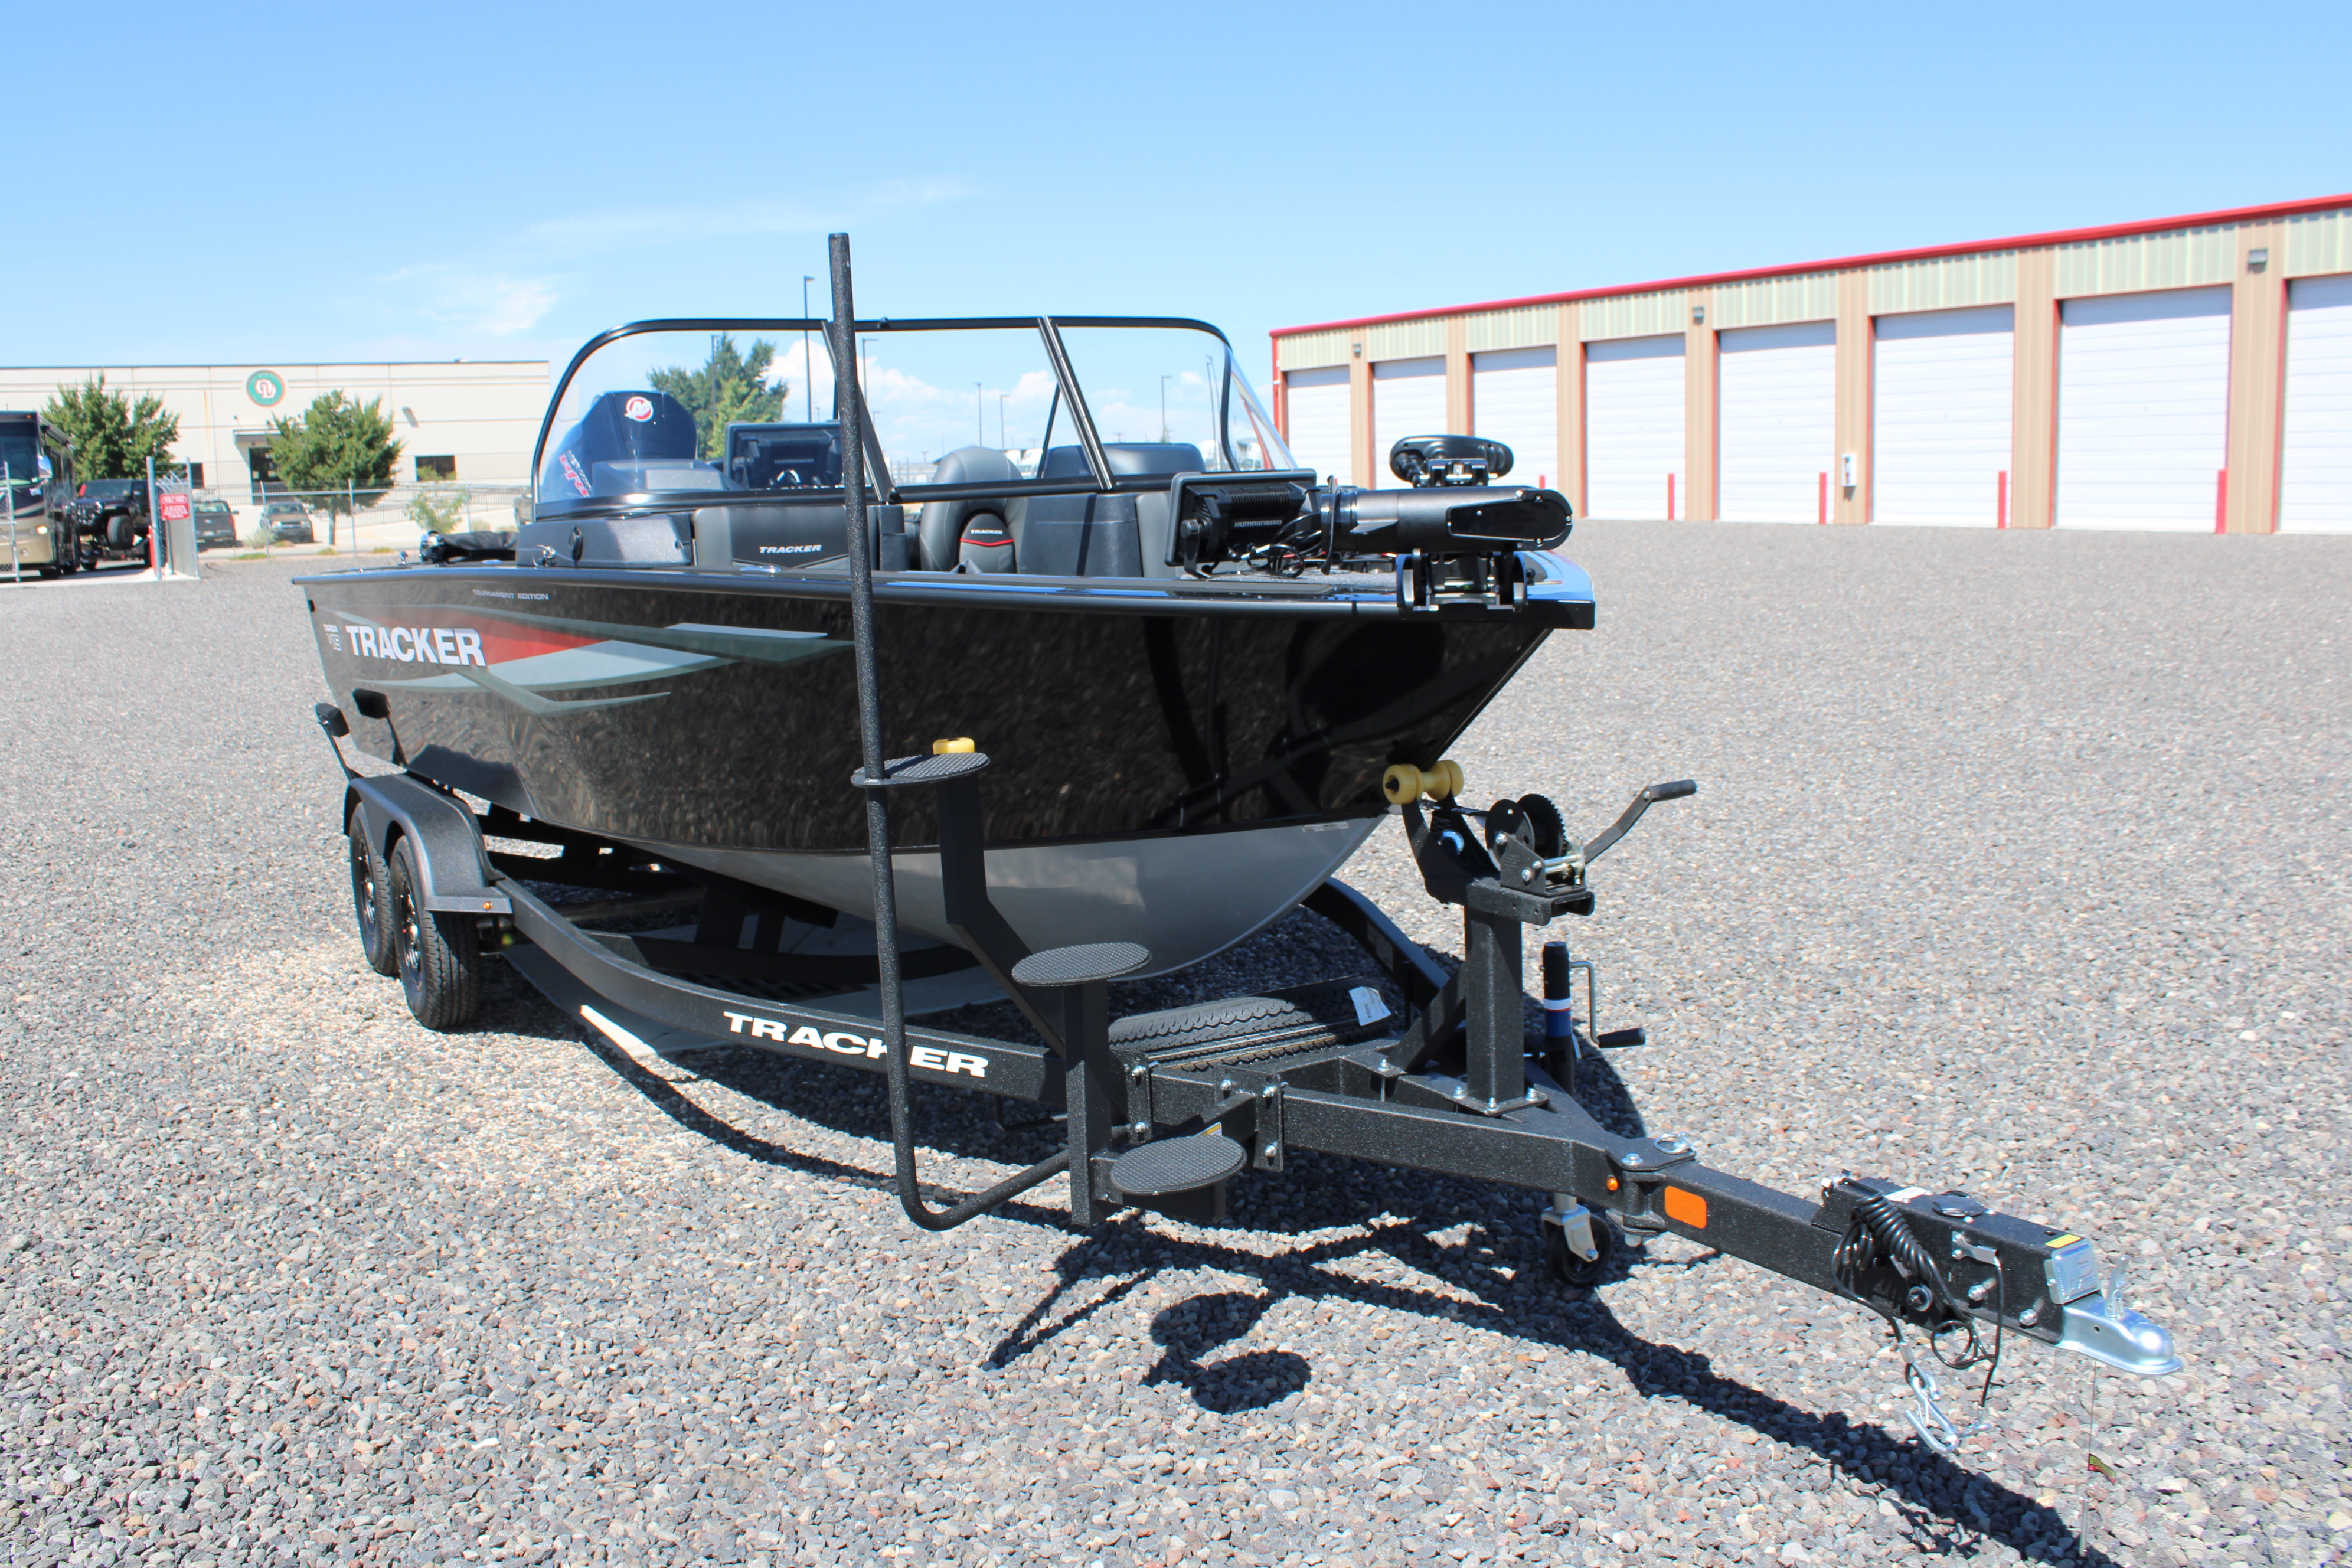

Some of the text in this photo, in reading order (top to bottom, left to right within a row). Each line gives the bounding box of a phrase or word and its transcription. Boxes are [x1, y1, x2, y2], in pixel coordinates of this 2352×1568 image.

[1234, 520, 1283, 528] HUMMINBIRD
[759, 544, 822, 554] TRACKER
[472, 589, 515, 599] TOURNAMENT
[345, 625, 487, 667] TRACKER
